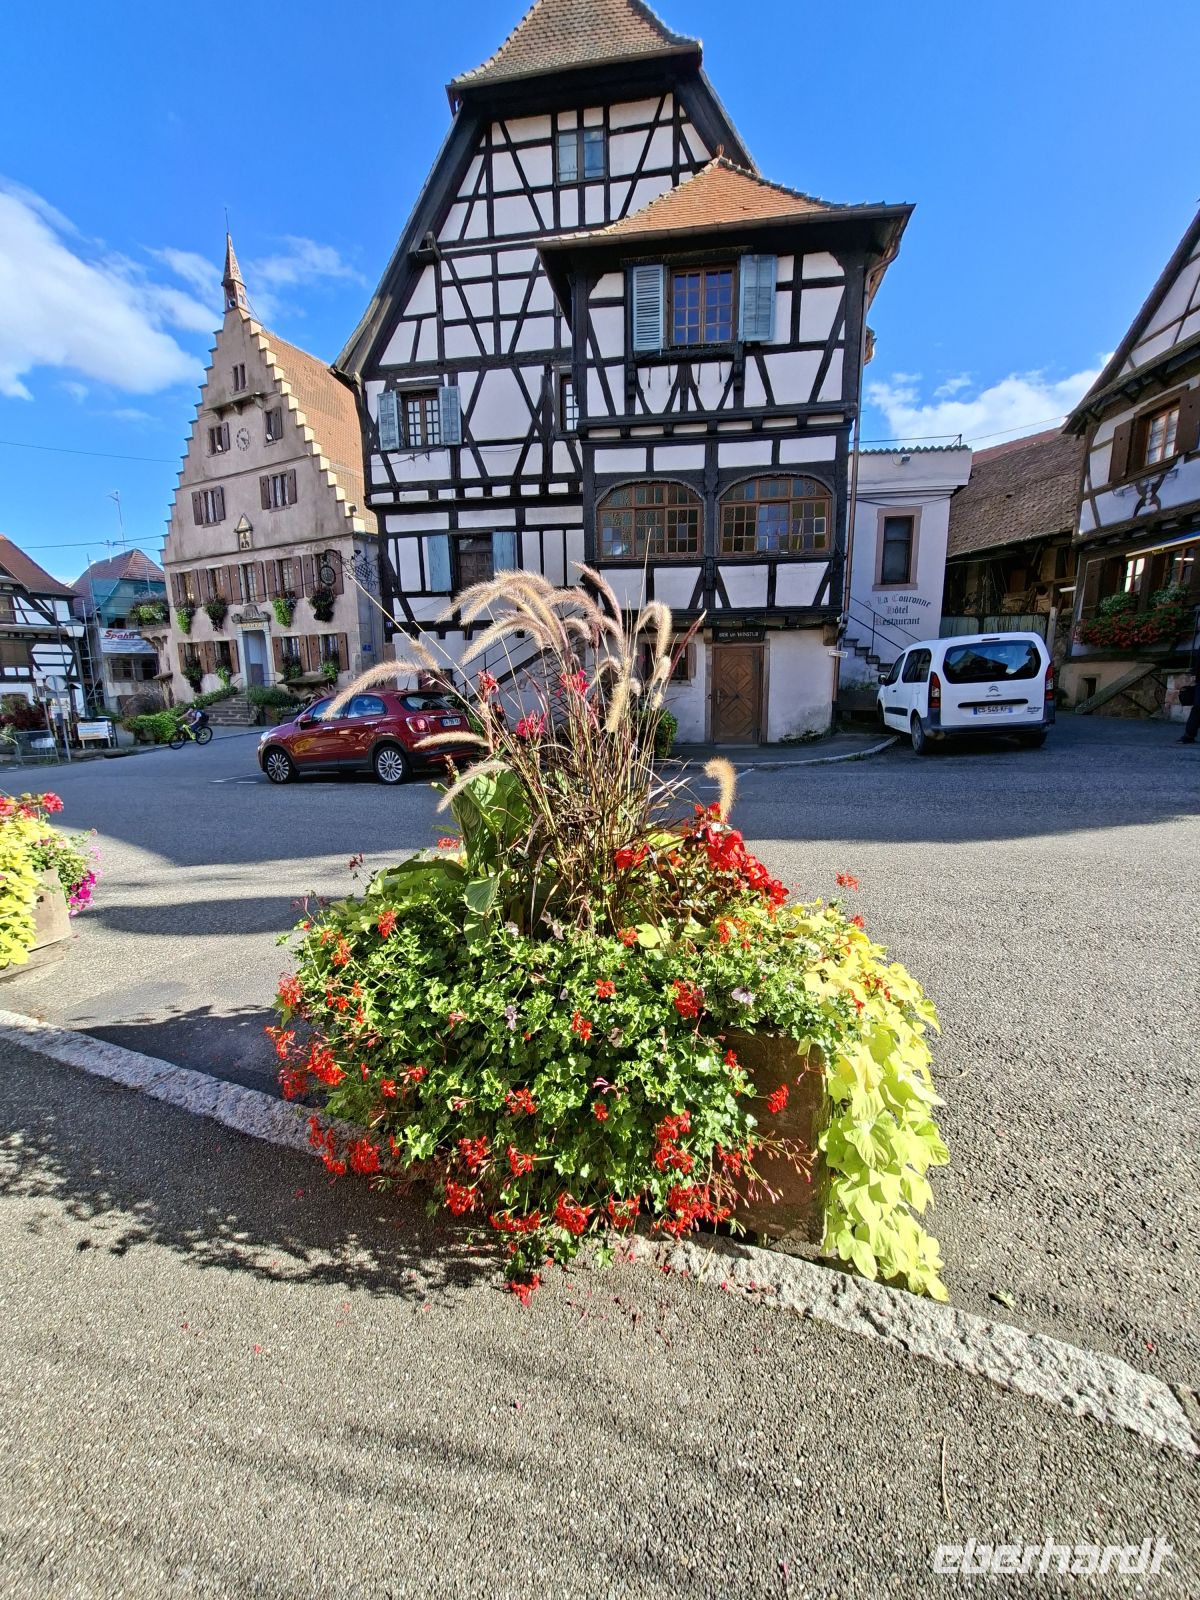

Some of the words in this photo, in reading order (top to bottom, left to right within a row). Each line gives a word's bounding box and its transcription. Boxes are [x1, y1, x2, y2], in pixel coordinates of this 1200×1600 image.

[892, 593, 931, 608] Couronne
[887, 605, 909, 614] Hôtel
[876, 617, 920, 625] Restaurant
